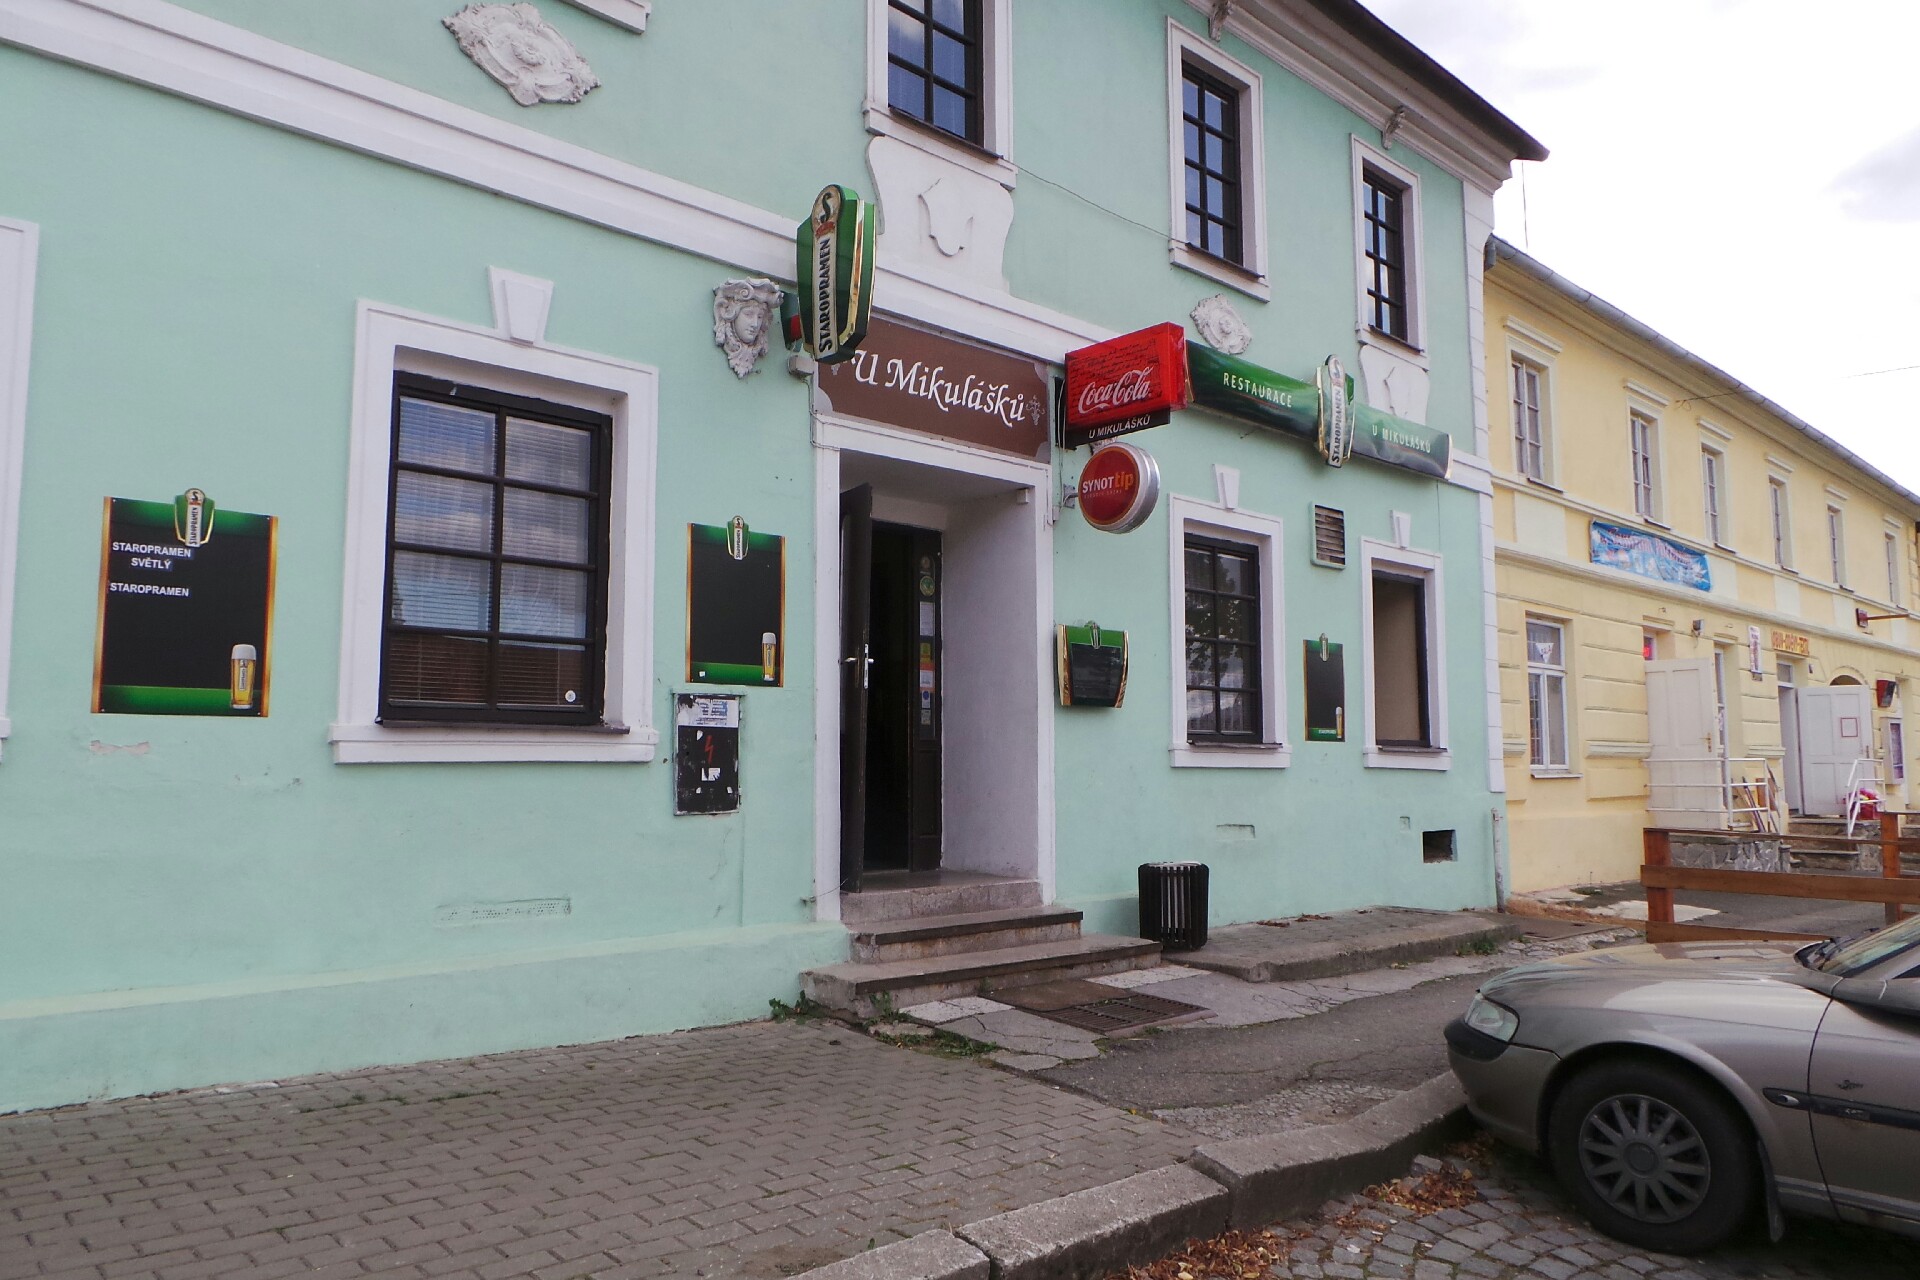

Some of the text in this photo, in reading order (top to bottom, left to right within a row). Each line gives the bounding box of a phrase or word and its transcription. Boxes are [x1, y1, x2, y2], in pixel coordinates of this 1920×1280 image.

[818, 238, 833, 354] STAROPRAMEN
[851, 350, 1026, 428] U Mikulášků
[1078, 366, 1154, 414] Coca-Cola
[1223, 372, 1293, 409] RESTAURACE
[1088, 415, 1151, 439] U MIKULÁŠKŮ
[1331, 387, 1342, 464] STAROPRAMEN
[1372, 424, 1378, 436] U
[1082, 476, 1115, 494] SYNOT
[1115, 471, 1134, 490] tip
[188, 506, 198, 546] STAROPRAMEN
[112, 541, 191, 558] STAROPRAMEN
[131, 557, 171, 569] SVĚTLÝ
[110, 582, 189, 597] STAROPRAMEN
